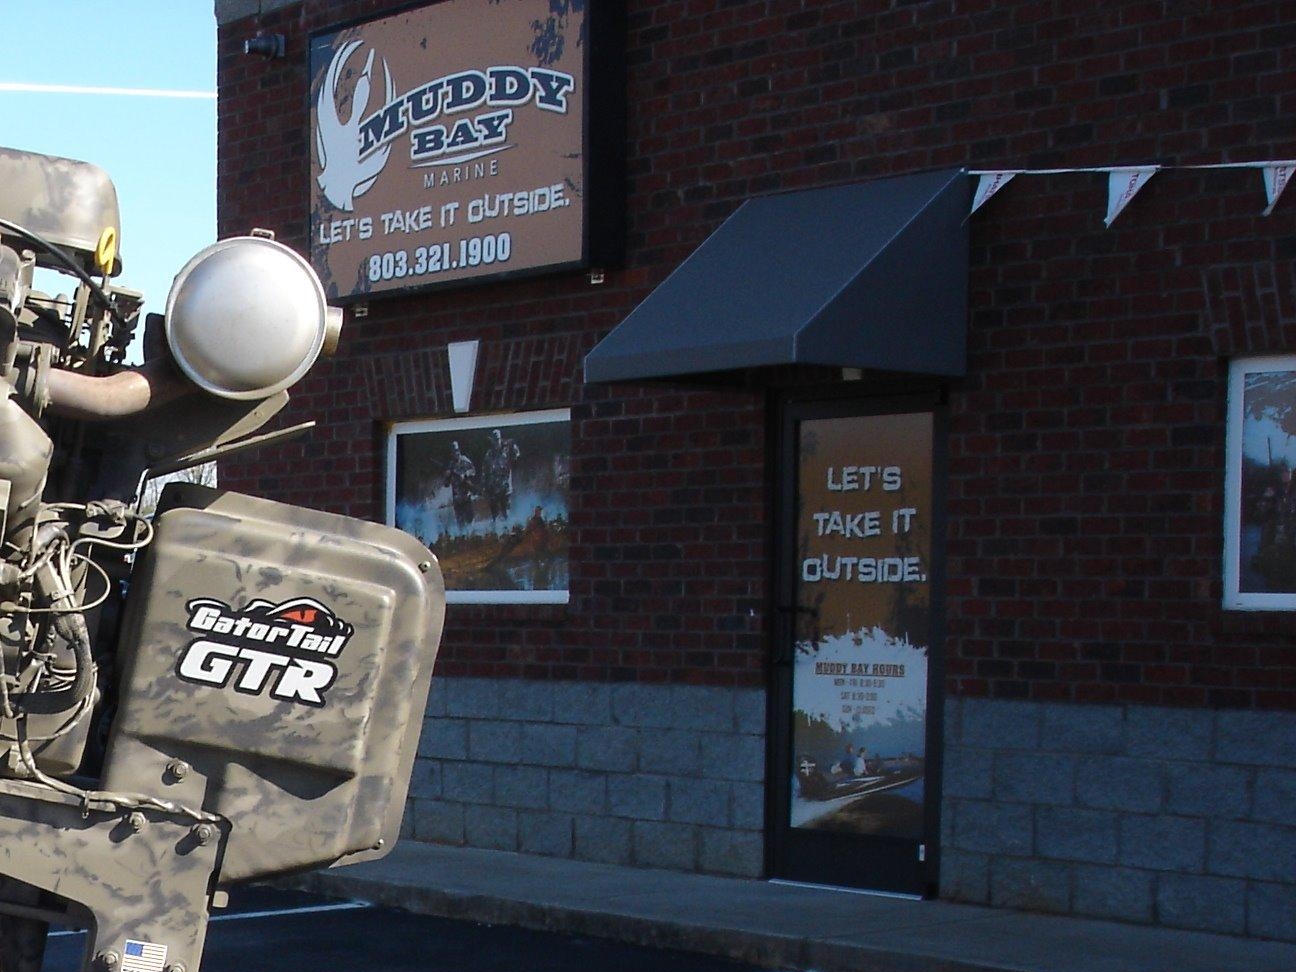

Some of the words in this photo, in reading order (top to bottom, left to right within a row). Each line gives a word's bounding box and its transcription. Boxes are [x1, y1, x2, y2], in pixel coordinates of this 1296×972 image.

[357, 66, 574, 163] MUDDY
[411, 109, 512, 160] BAY
[423, 160, 499, 188] MARINE
[319, 217, 373, 245] LET'S
[381, 206, 433, 235] TAKE
[440, 202, 459, 228] IT
[468, 183, 571, 224] OUTSIDE.
[368, 233, 512, 283] 803.321.1900
[827, 466, 902, 491] LET'S
[813, 511, 881, 539] TAKE
[892, 507, 917, 534] IT
[802, 553, 927, 583] OUTSIDE.
[189, 605, 346, 655] GatorTail
[179, 640, 335, 704] GTR
[815, 662, 848, 675] MUDDY
[851, 663, 869, 675] BAY
[872, 664, 905, 676] HOURS
